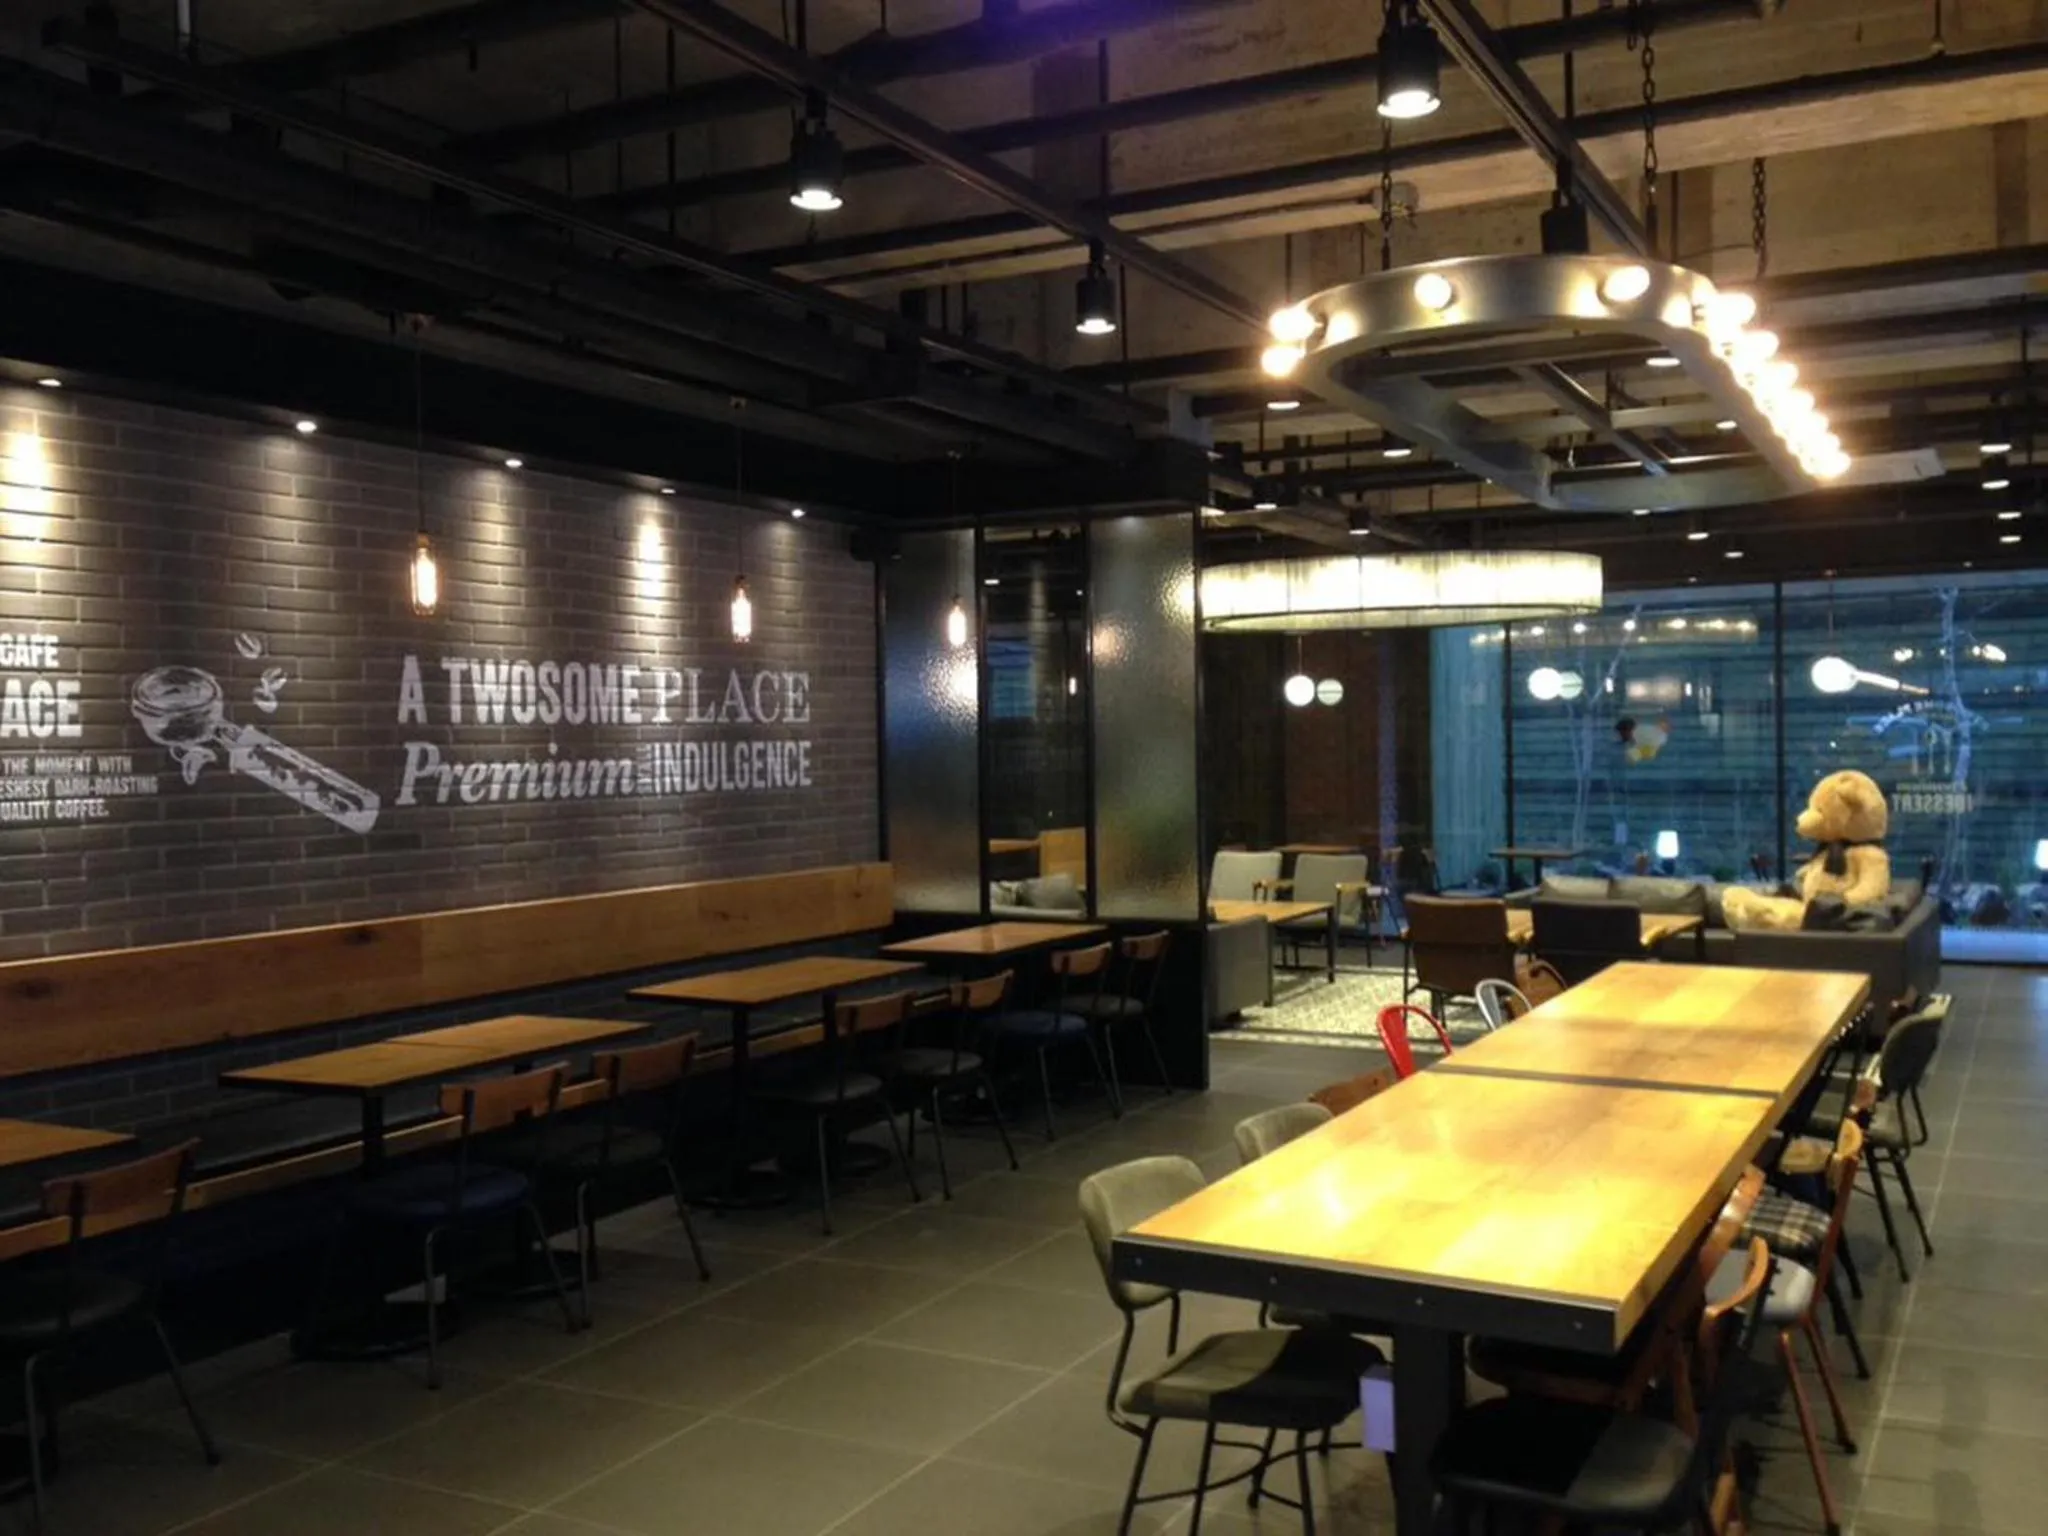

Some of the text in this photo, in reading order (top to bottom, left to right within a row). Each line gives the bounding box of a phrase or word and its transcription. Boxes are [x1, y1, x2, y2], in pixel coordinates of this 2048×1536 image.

[0, 633, 59, 668] CAFE
[397, 654, 811, 725] A TWOSOME PLACE
[3, 755, 132, 775] THE MOMENT WITH
[395, 741, 637, 806] Premium
[655, 740, 812, 793] INDULGENCE
[55, 798, 109, 818] COFFEE.
